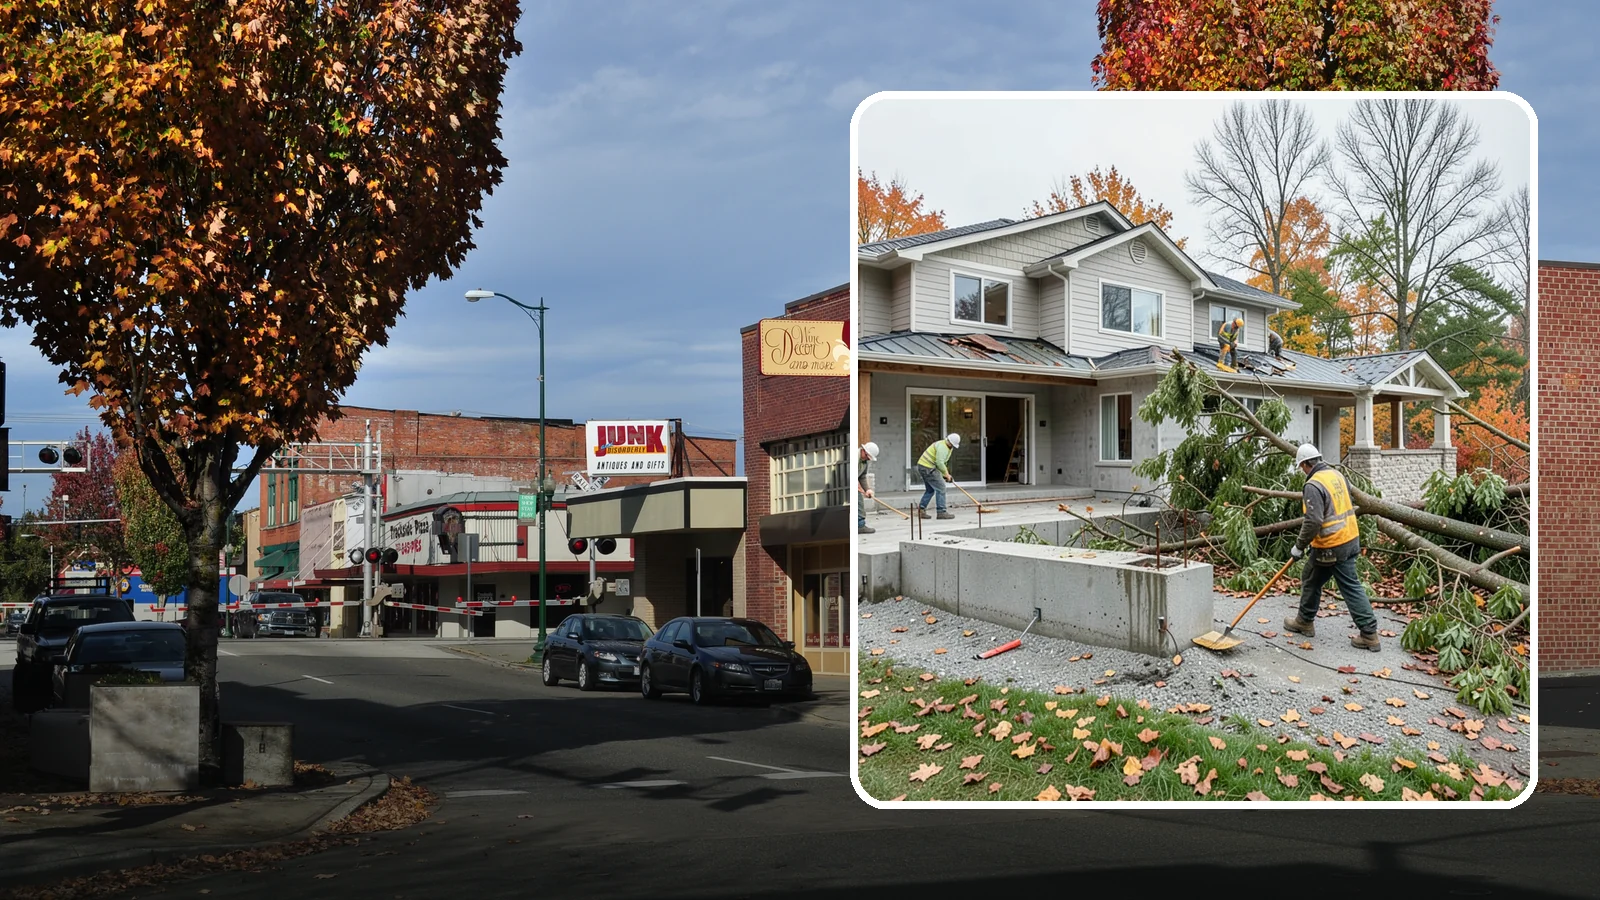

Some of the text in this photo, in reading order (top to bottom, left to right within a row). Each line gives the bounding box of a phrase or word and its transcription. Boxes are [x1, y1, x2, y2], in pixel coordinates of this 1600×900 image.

[595, 425, 664, 457] JUNK
[607, 446, 646, 454] DISORDERLY
[597, 460, 665, 470] ANTIQUES AND GIFTS
[573, 473, 588, 491] RAIL
[390, 521, 413, 539] Trackside
